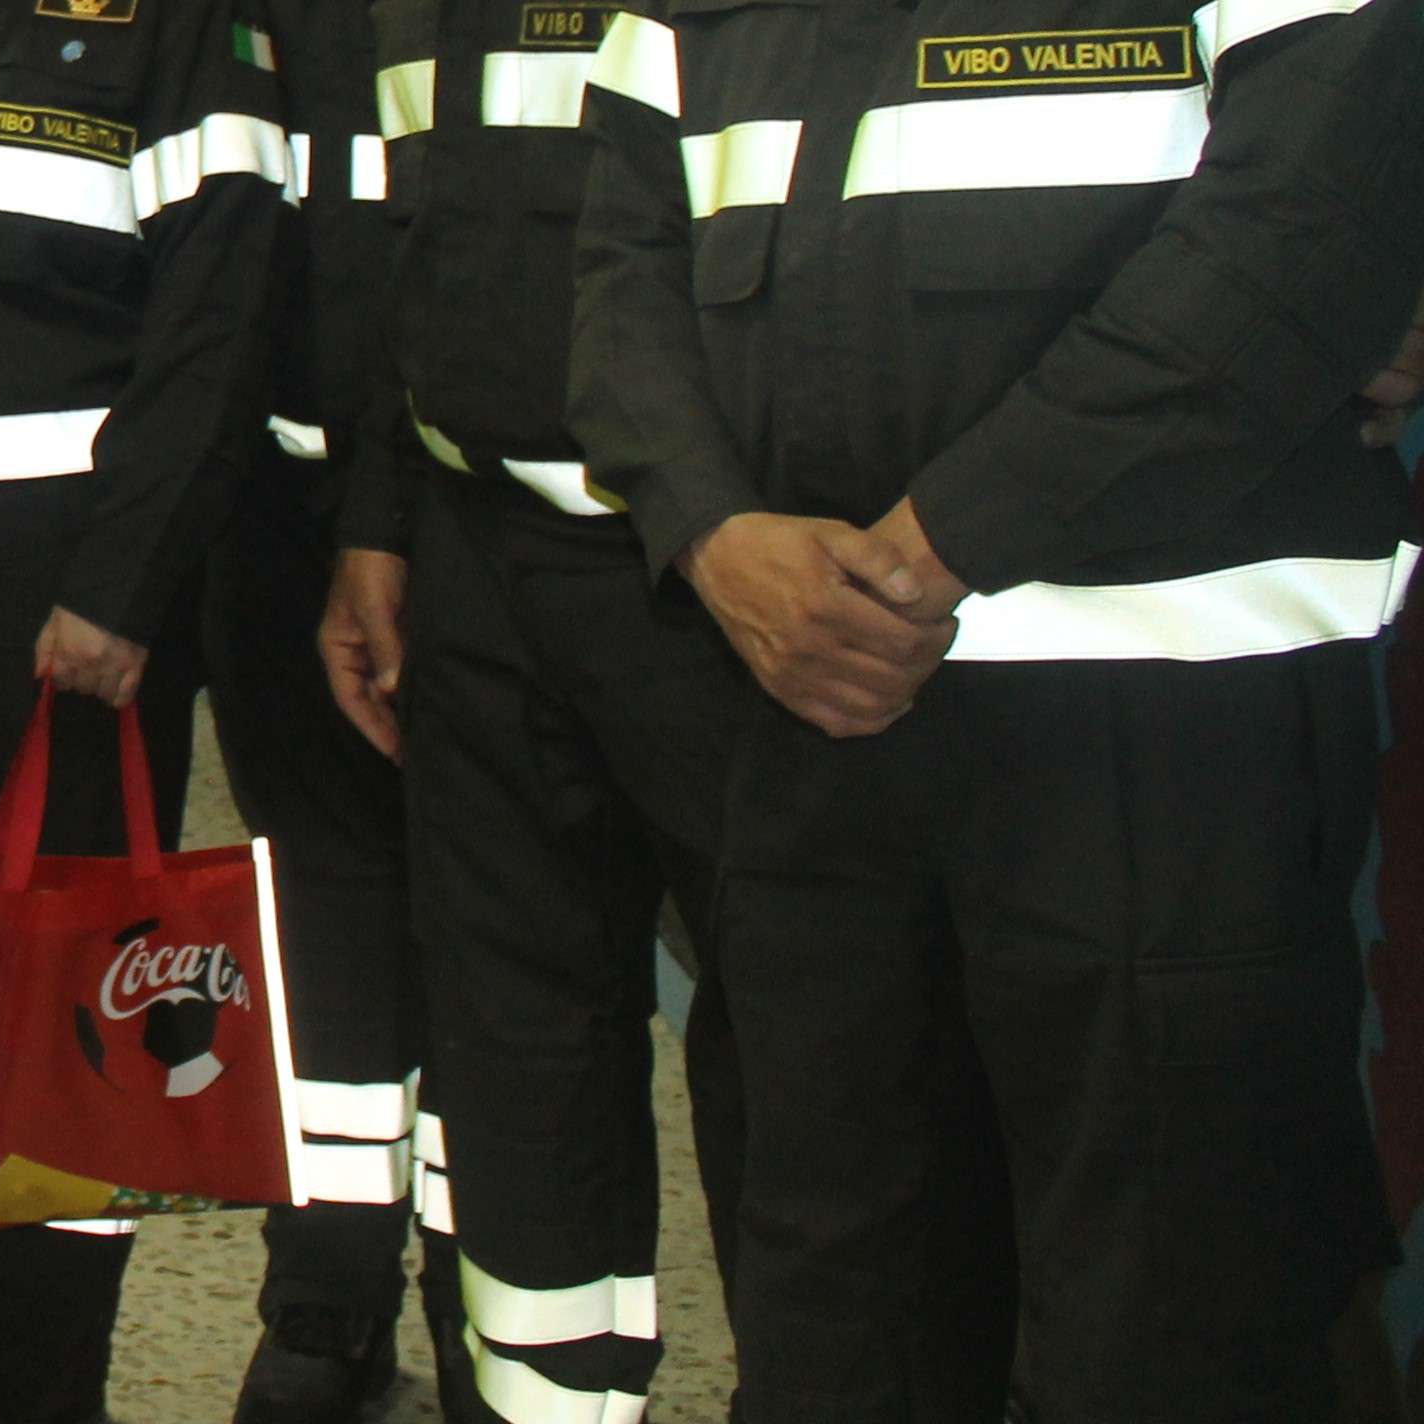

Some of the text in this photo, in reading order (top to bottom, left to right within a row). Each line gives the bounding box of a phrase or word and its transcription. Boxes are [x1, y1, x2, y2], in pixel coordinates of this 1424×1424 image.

[533, 11, 584, 35] VIBO
[944, 41, 1164, 75] VIBO VALENTIA
[43, 117, 121, 151] VALENTIA
